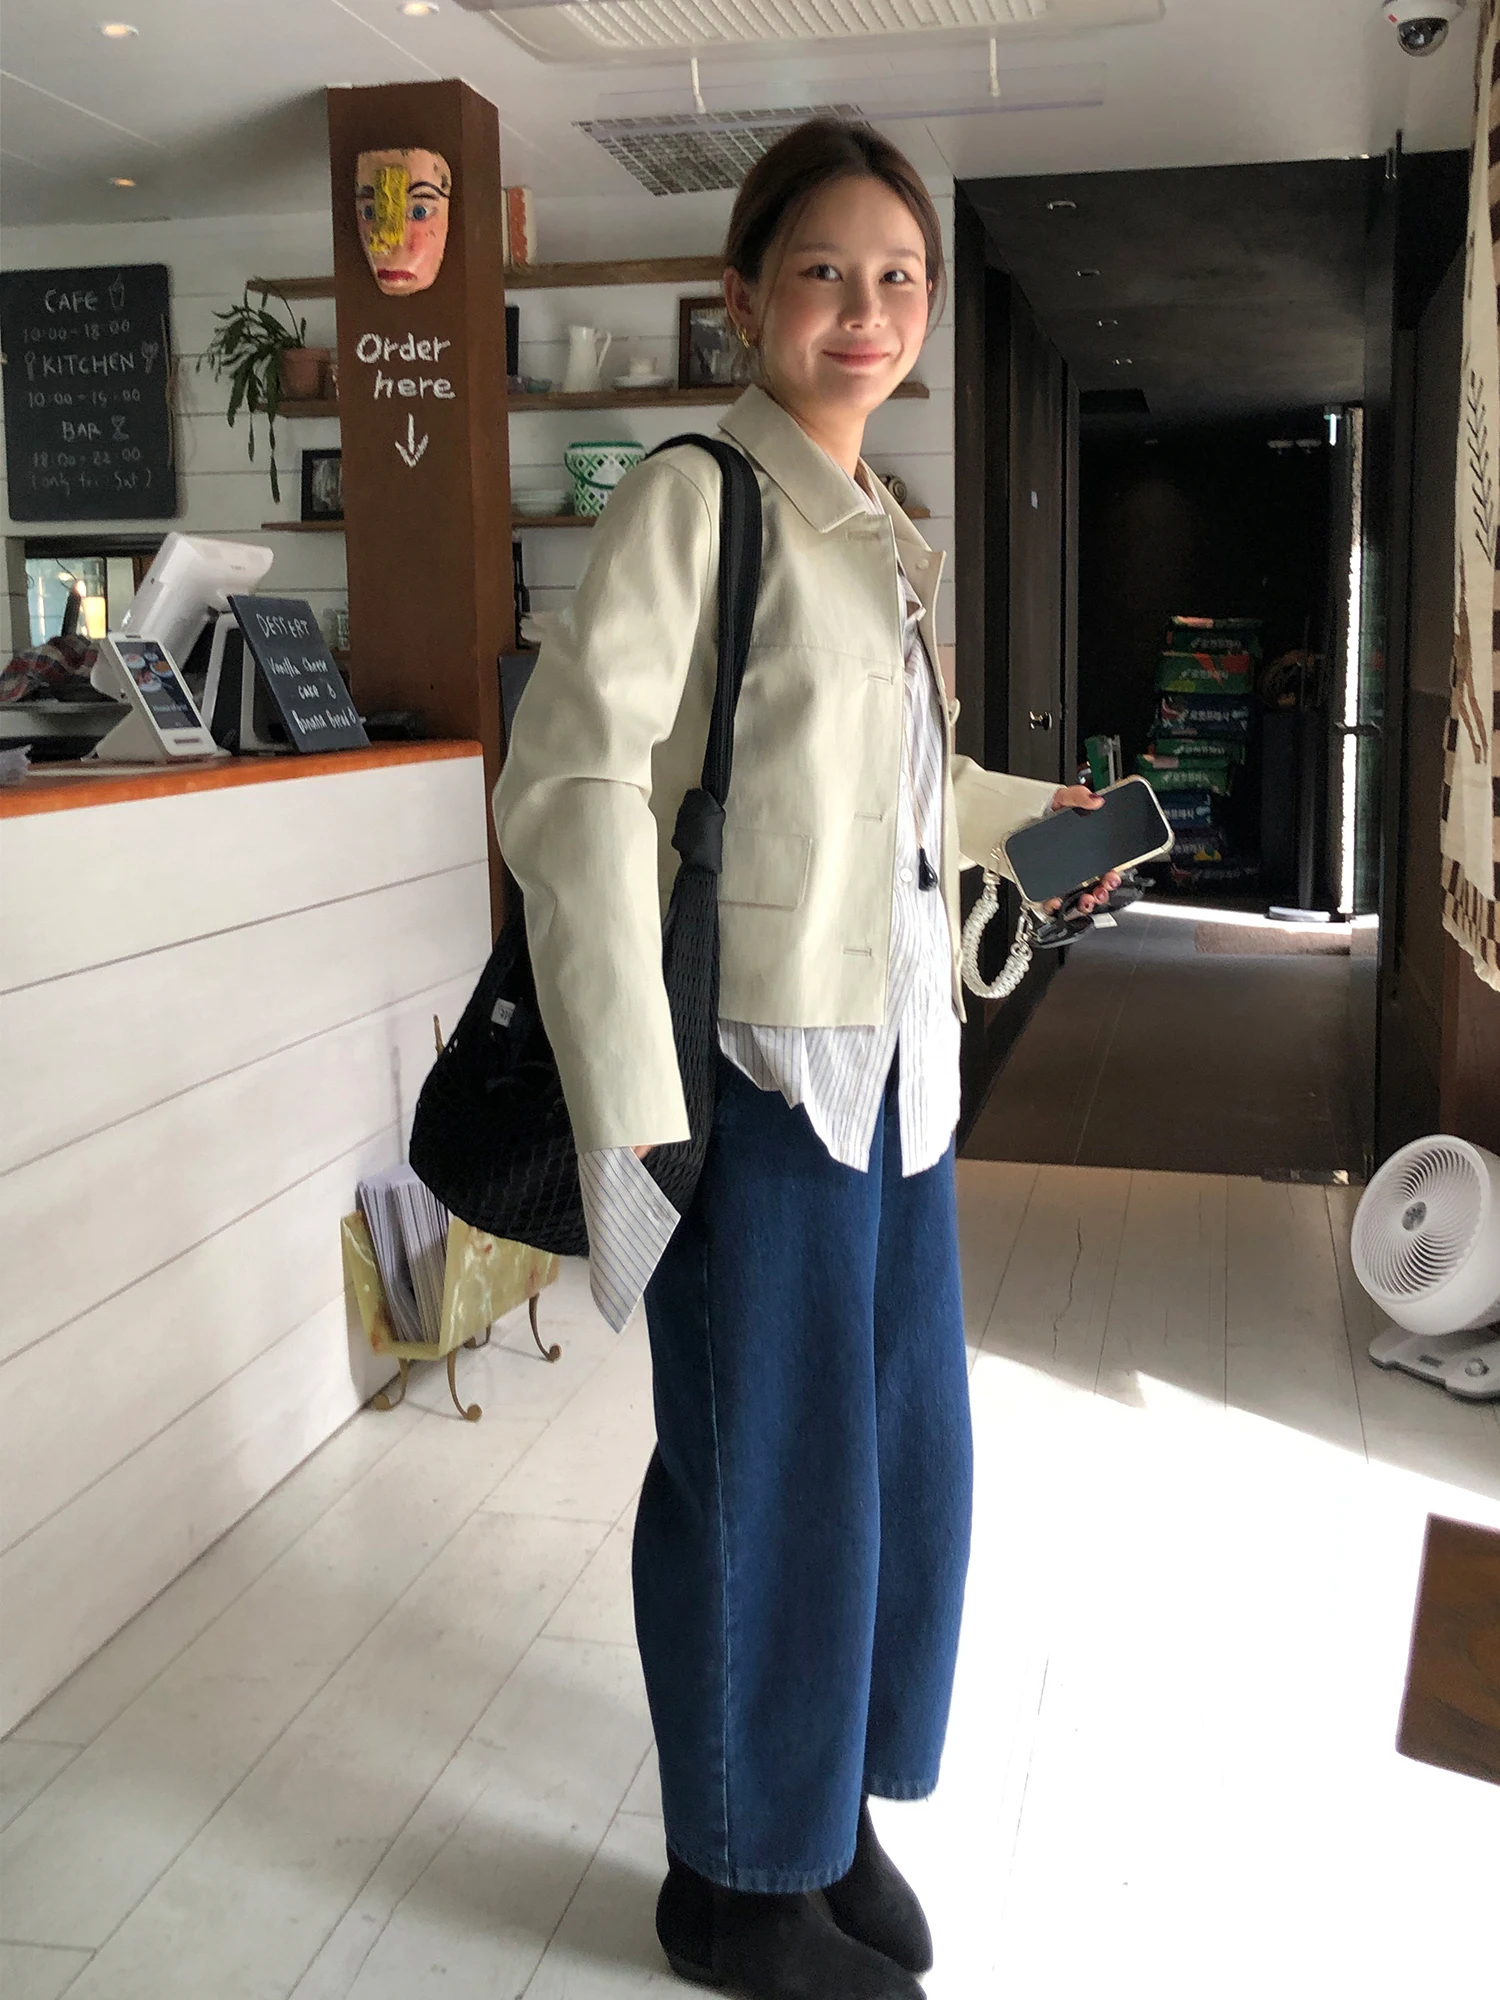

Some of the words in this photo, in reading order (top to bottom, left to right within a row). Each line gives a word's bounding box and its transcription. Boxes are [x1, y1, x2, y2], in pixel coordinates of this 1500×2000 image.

[44, 288, 98, 313] CAFE
[355, 331, 451, 364] Order
[42, 352, 135, 377] KITCHEN
[373, 368, 456, 400] here
[61, 420, 102, 442] BAR
[255, 613, 310, 638] DESSERT
[266, 656, 301, 678] Vanilla
